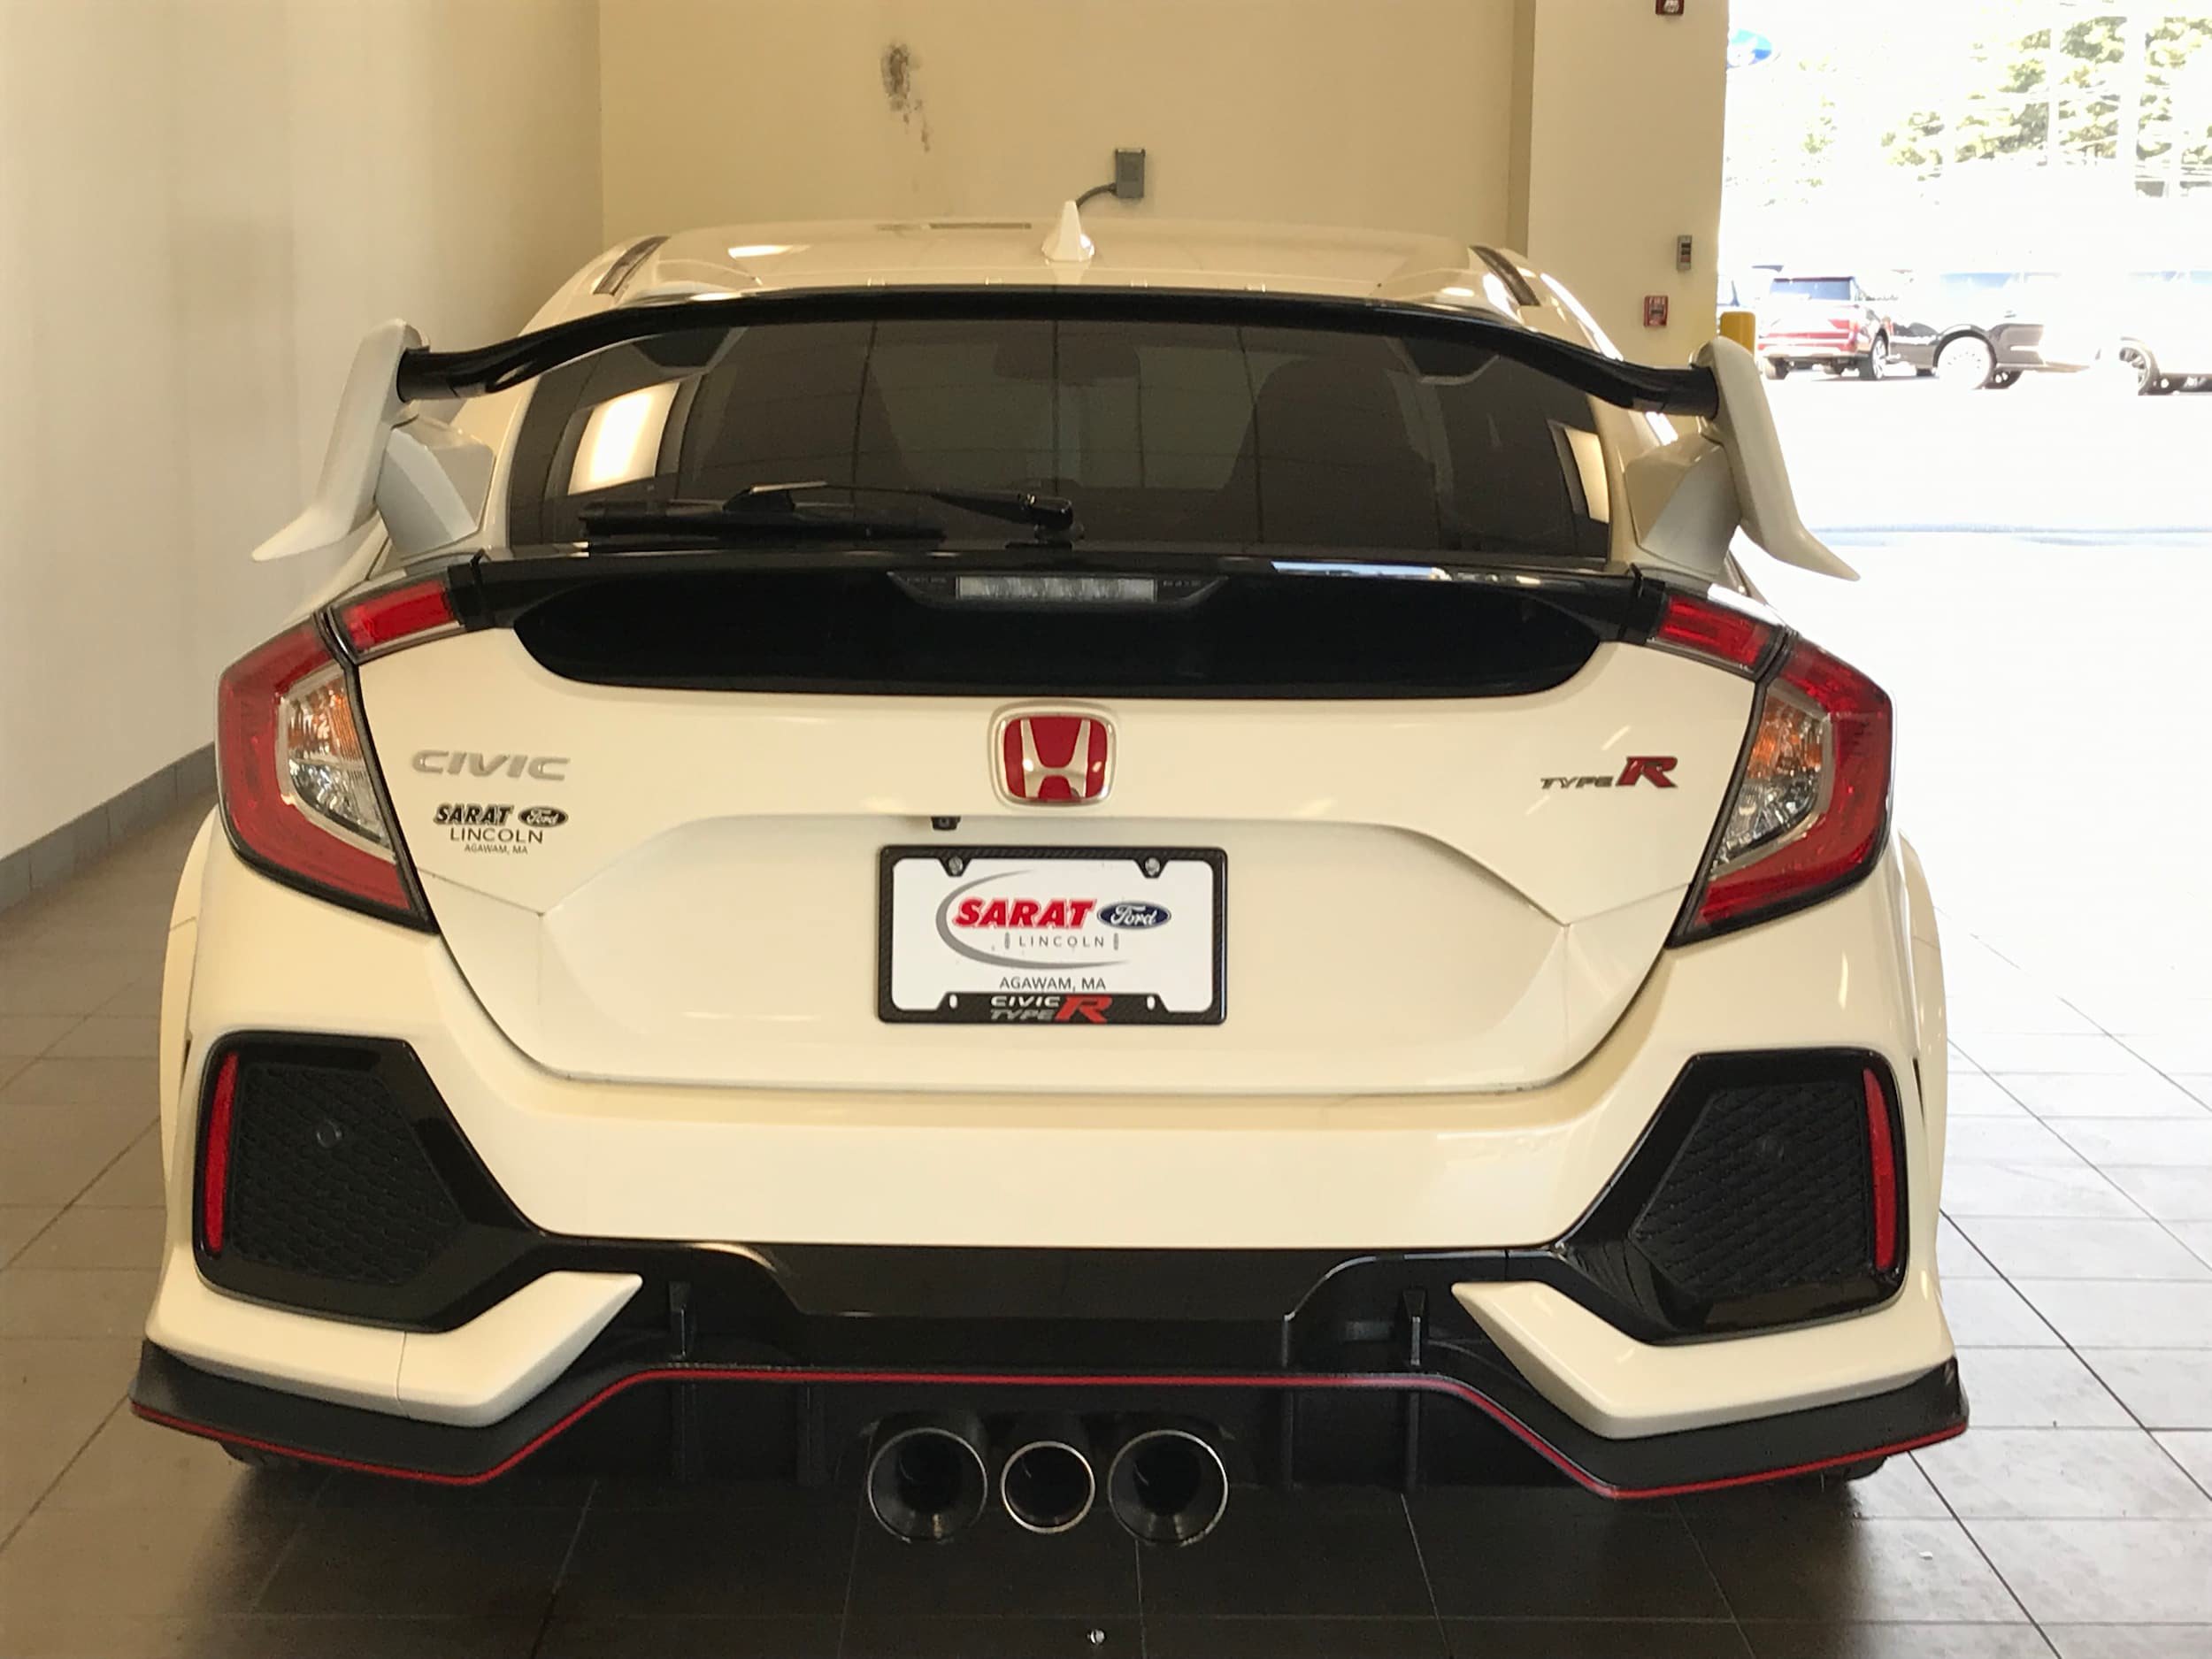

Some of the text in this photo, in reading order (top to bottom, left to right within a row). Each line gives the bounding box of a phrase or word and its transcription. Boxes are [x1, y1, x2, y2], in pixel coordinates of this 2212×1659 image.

[412, 749, 571, 780] CIVIC
[1540, 756, 1678, 789] TYPE R
[433, 803, 559, 826] SARAT Ford
[449, 827, 543, 844] LINCOLN
[464, 843, 528, 855] AGAWAM, MA
[953, 897, 1159, 929] SARAT Ford
[1018, 934, 1105, 949] LINCOLN
[999, 976, 1106, 992] AGAWAM, MA
[990, 995, 1061, 1008] CIVIC
[990, 995, 1113, 1023] TYPE R
